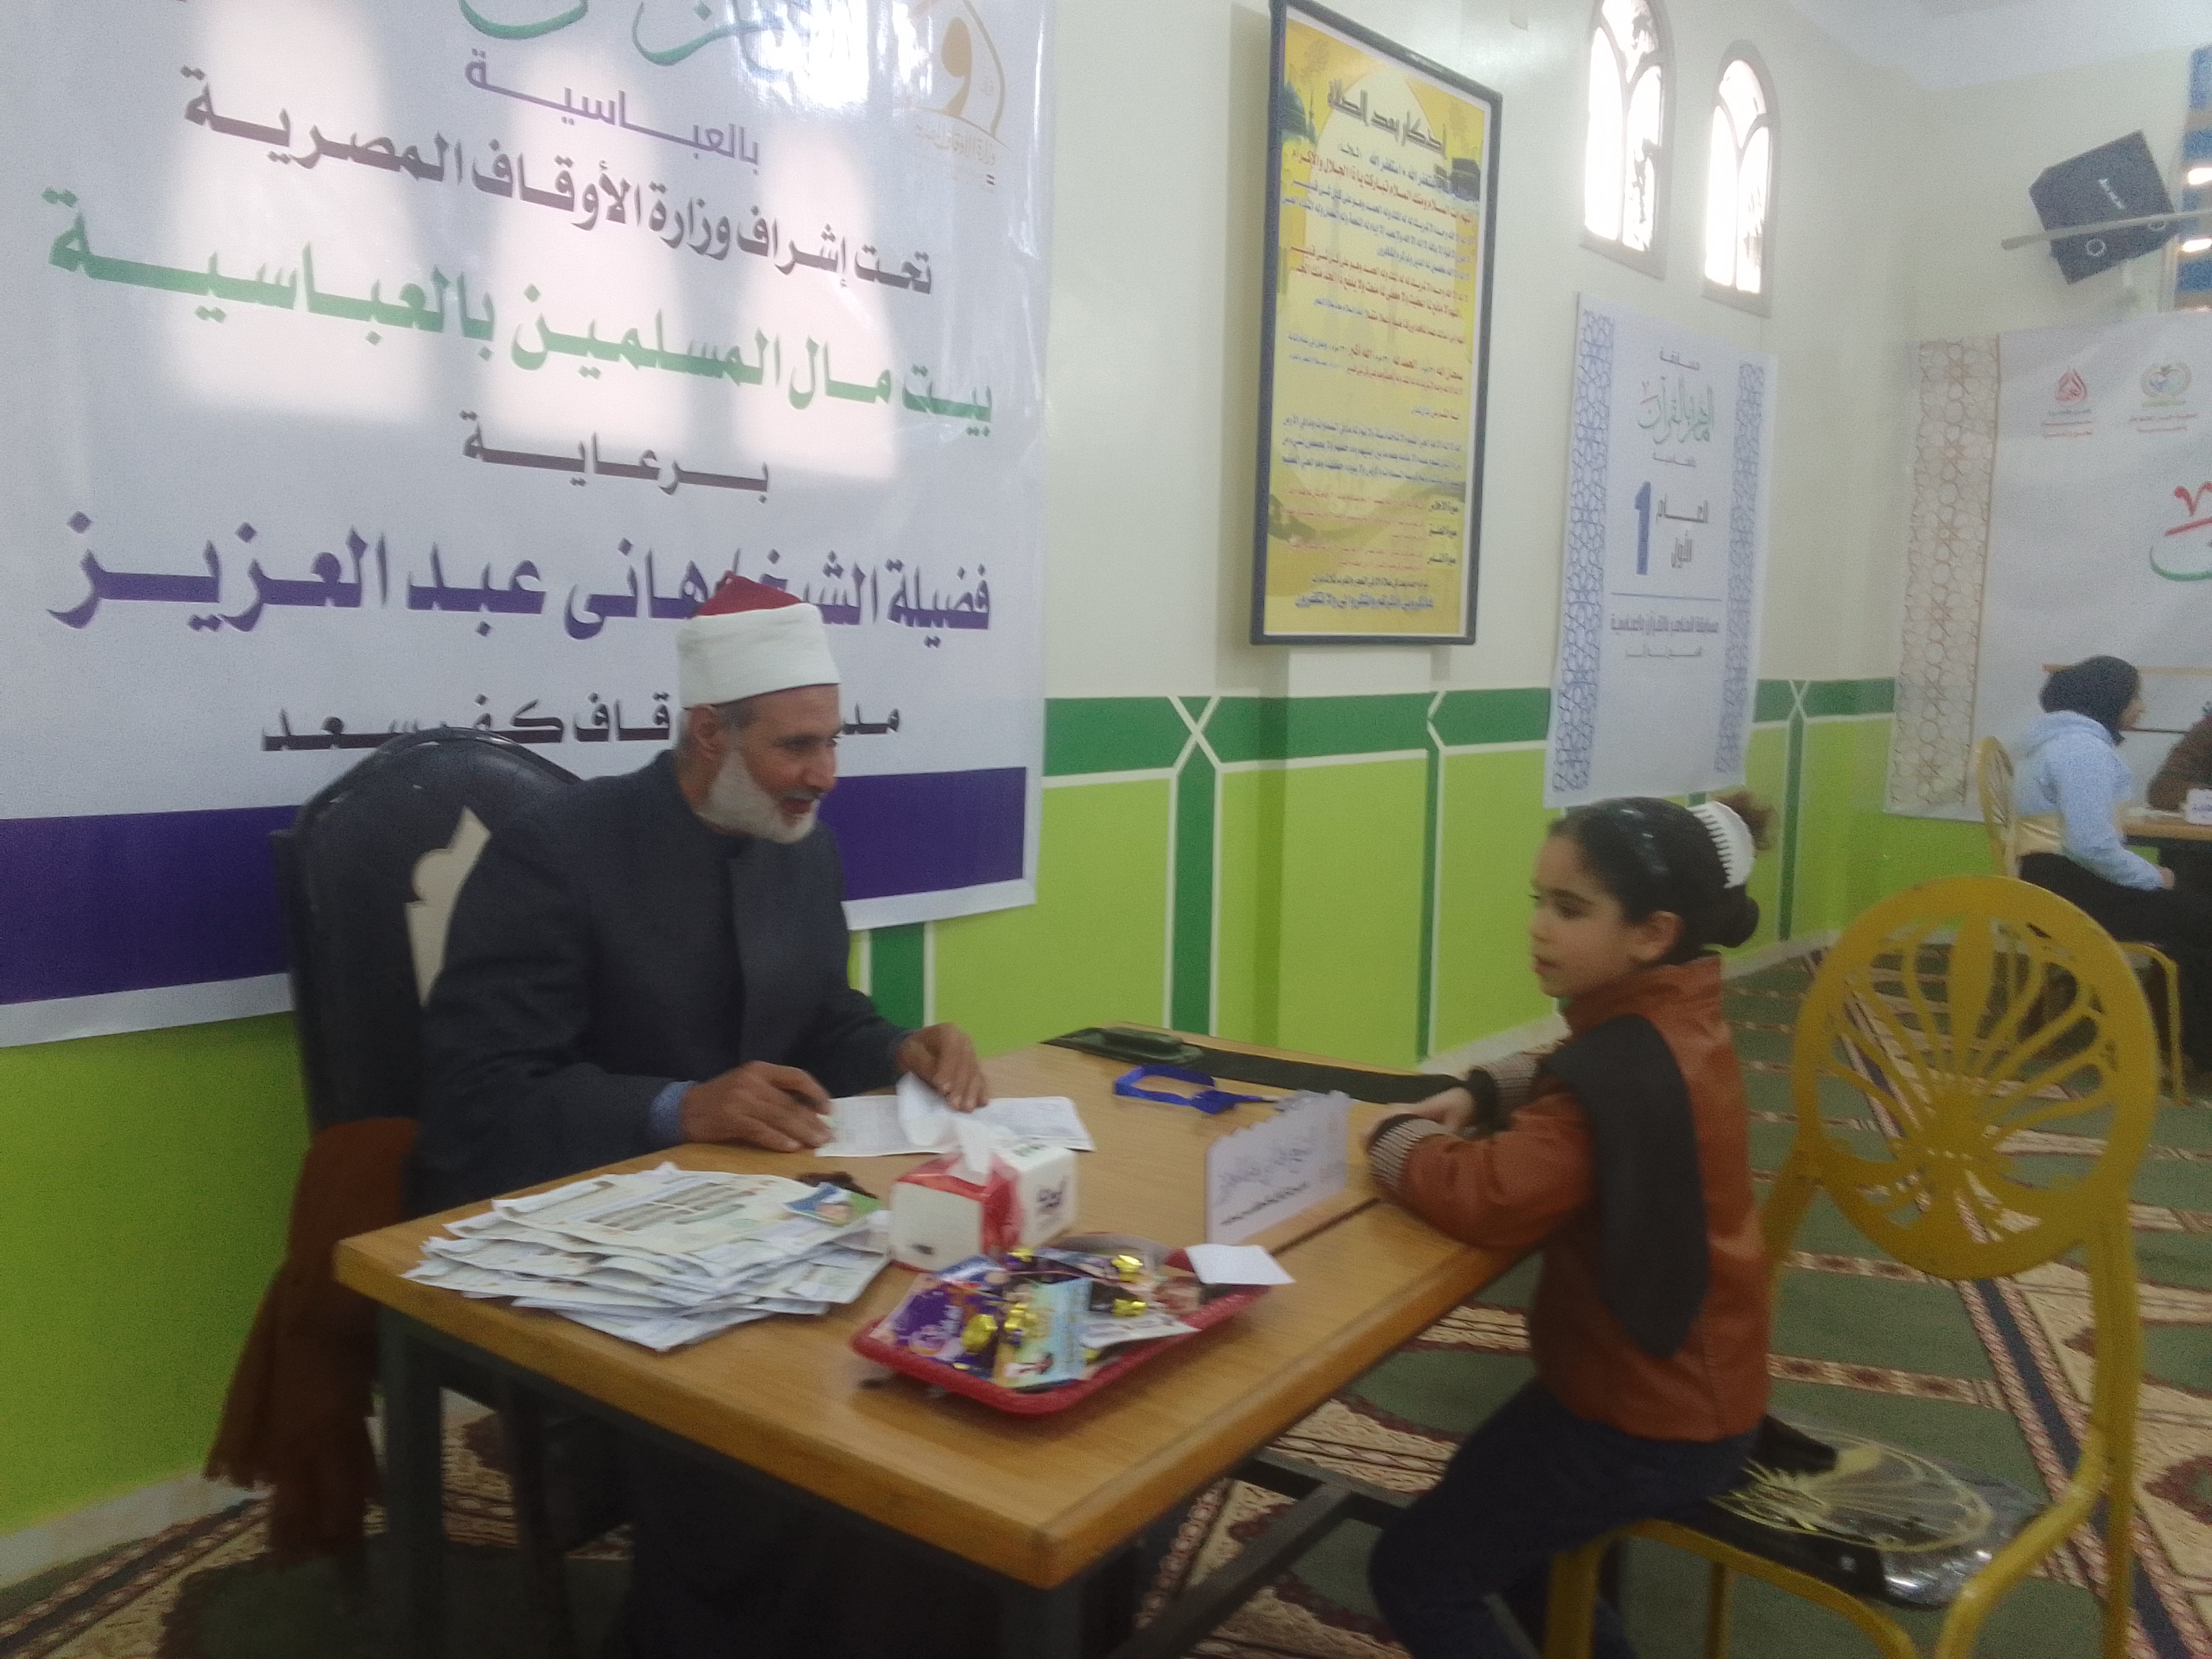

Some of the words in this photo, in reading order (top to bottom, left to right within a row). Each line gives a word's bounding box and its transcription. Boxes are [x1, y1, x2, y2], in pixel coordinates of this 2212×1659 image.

[181, 65, 463, 185] المصرية
[465, 49, 760, 175] بالعباسية
[472, 139, 641, 230] الأوقاف
[648, 182, 731, 260] وزارة
[41, 186, 495, 361] بالعباسية
[737, 205, 846, 288] إشراف
[853, 245, 932, 294] تحت
[510, 283, 780, 387] المسلمين
[789, 335, 891, 410] مال
[902, 364, 992, 437] بيت
[460, 411, 768, 503] برعاية
[46, 512, 388, 632] العزيز
[1634, 480, 1652, 575] 1
[407, 543, 546, 636] عبد
[886, 558, 990, 648] فضيلة
[438, 693, 563, 743] كف
[574, 691, 670, 743] قاف
